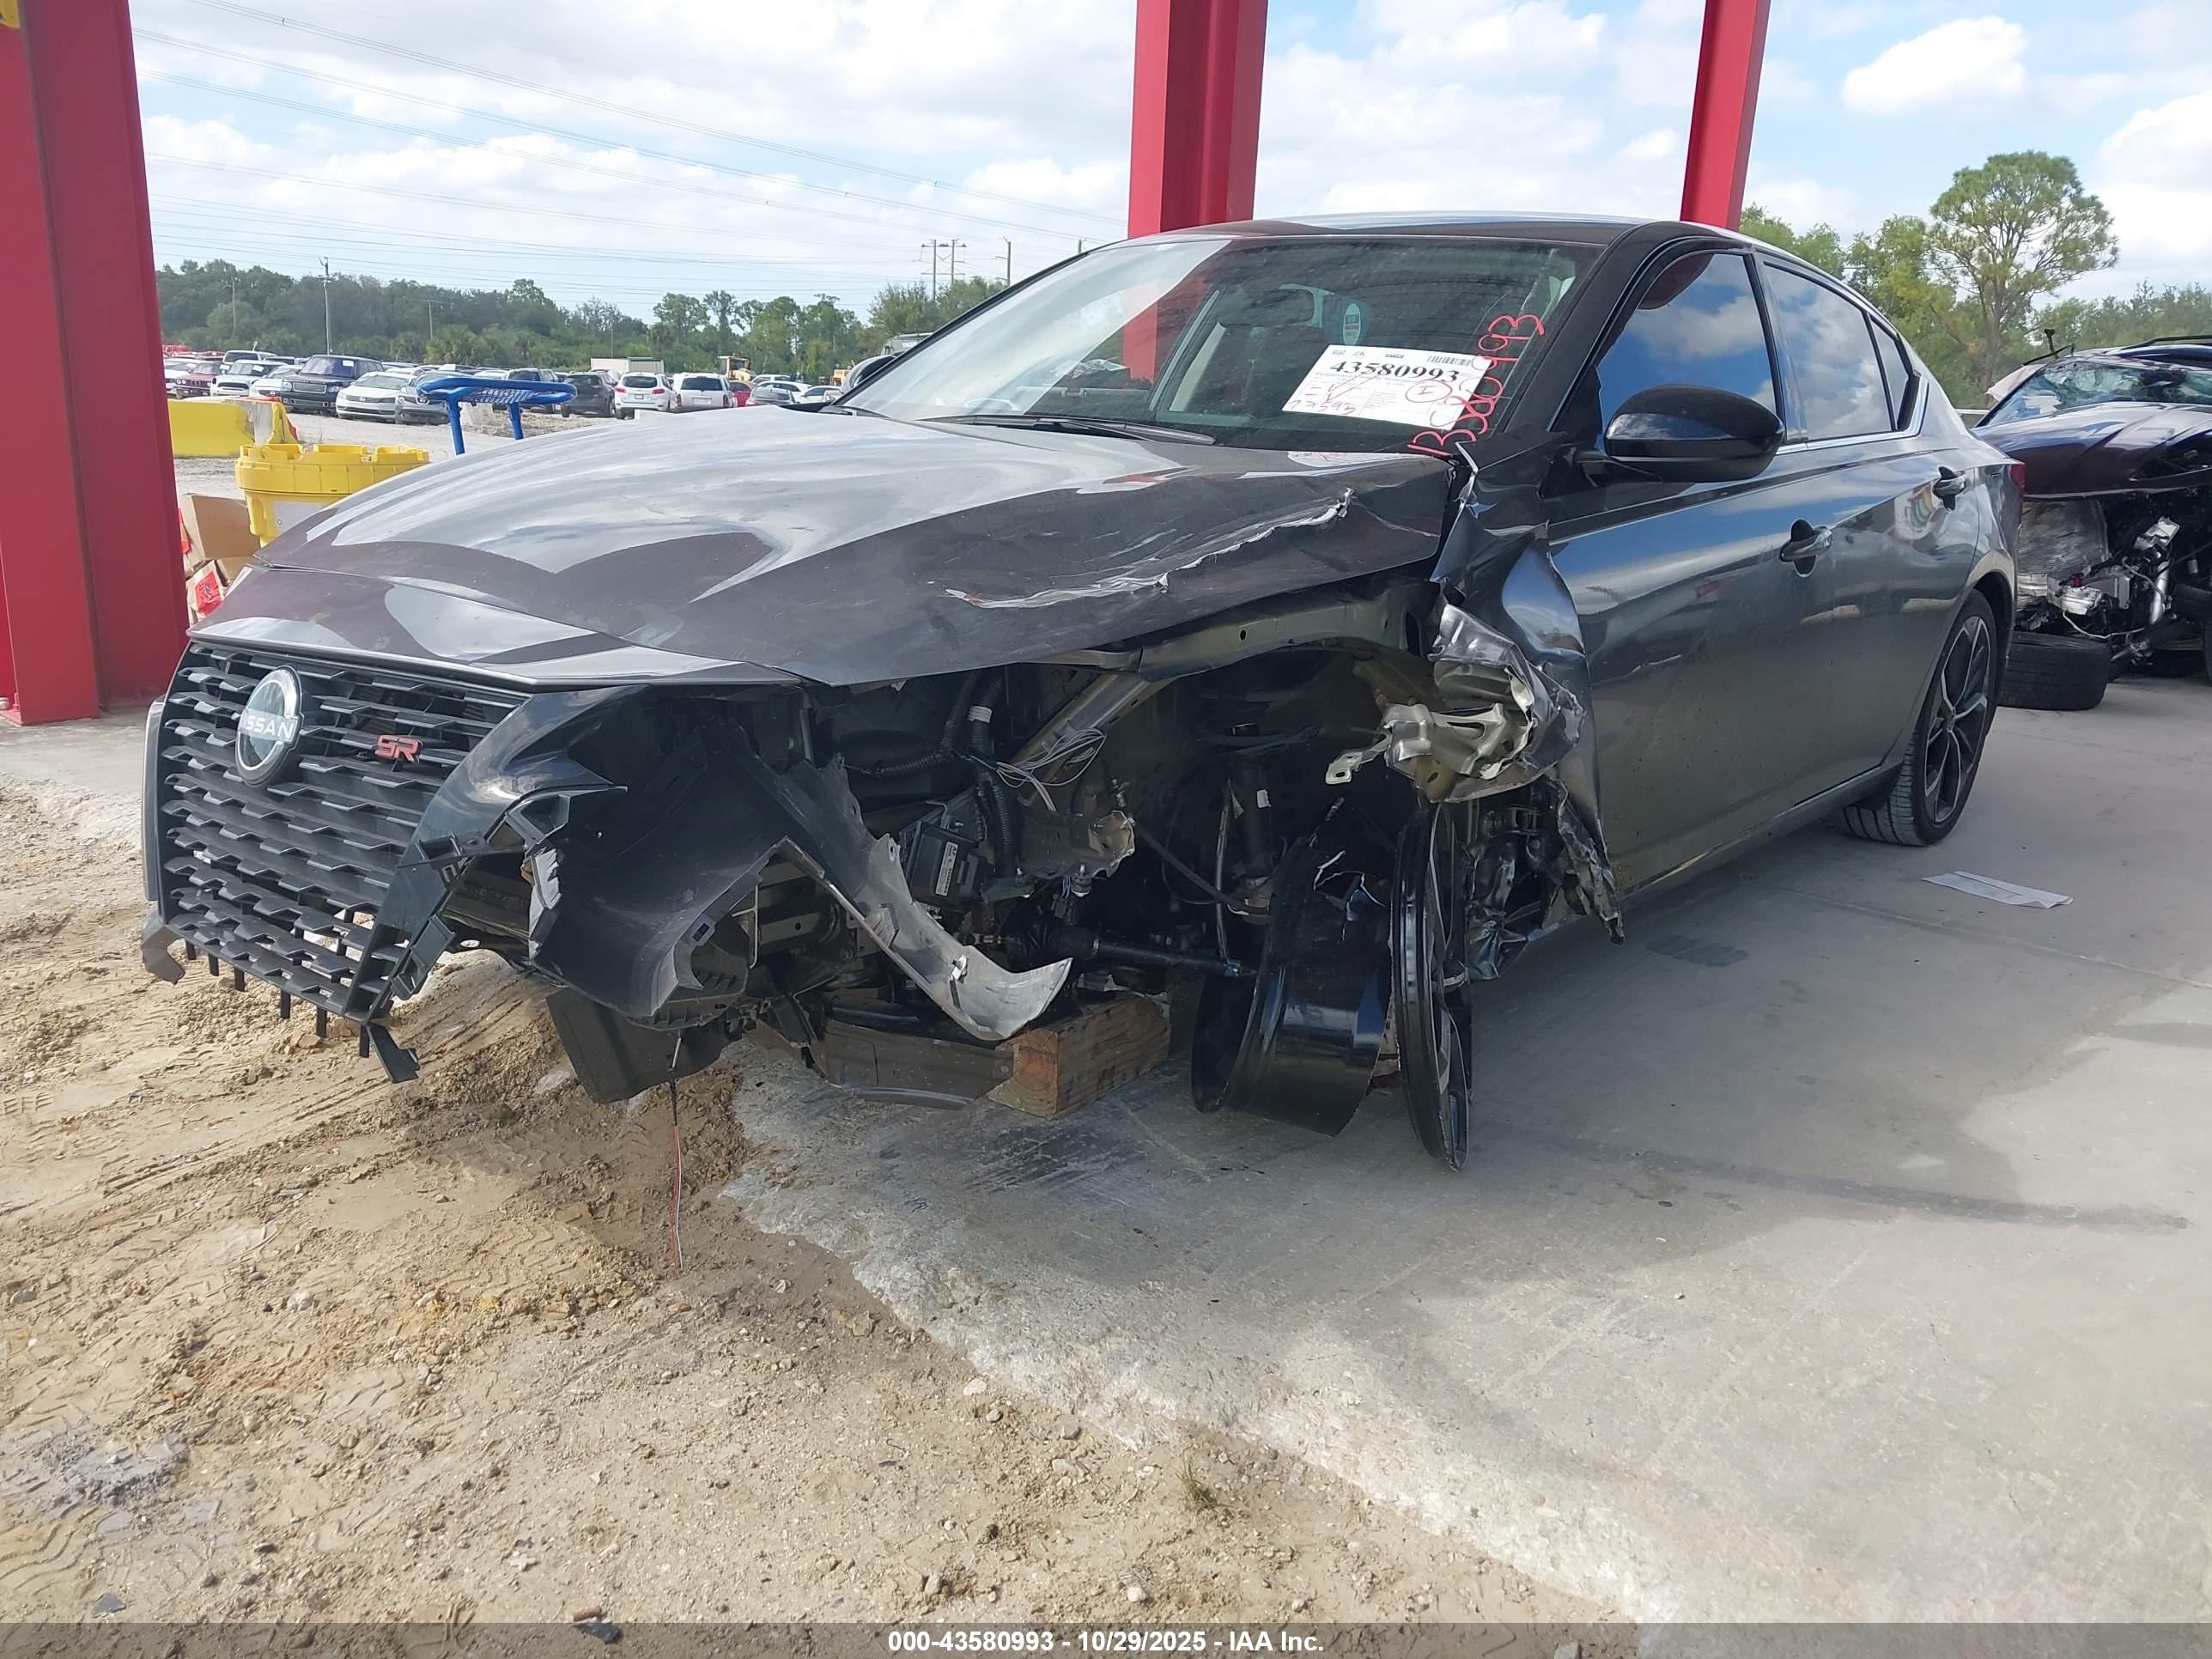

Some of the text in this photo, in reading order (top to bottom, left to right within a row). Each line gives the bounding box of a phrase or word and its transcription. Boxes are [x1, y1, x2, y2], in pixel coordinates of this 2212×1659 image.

[1330, 361, 1460, 382] 43580993
[240, 714, 295, 739] SSAN
[374, 735, 419, 763] SR
